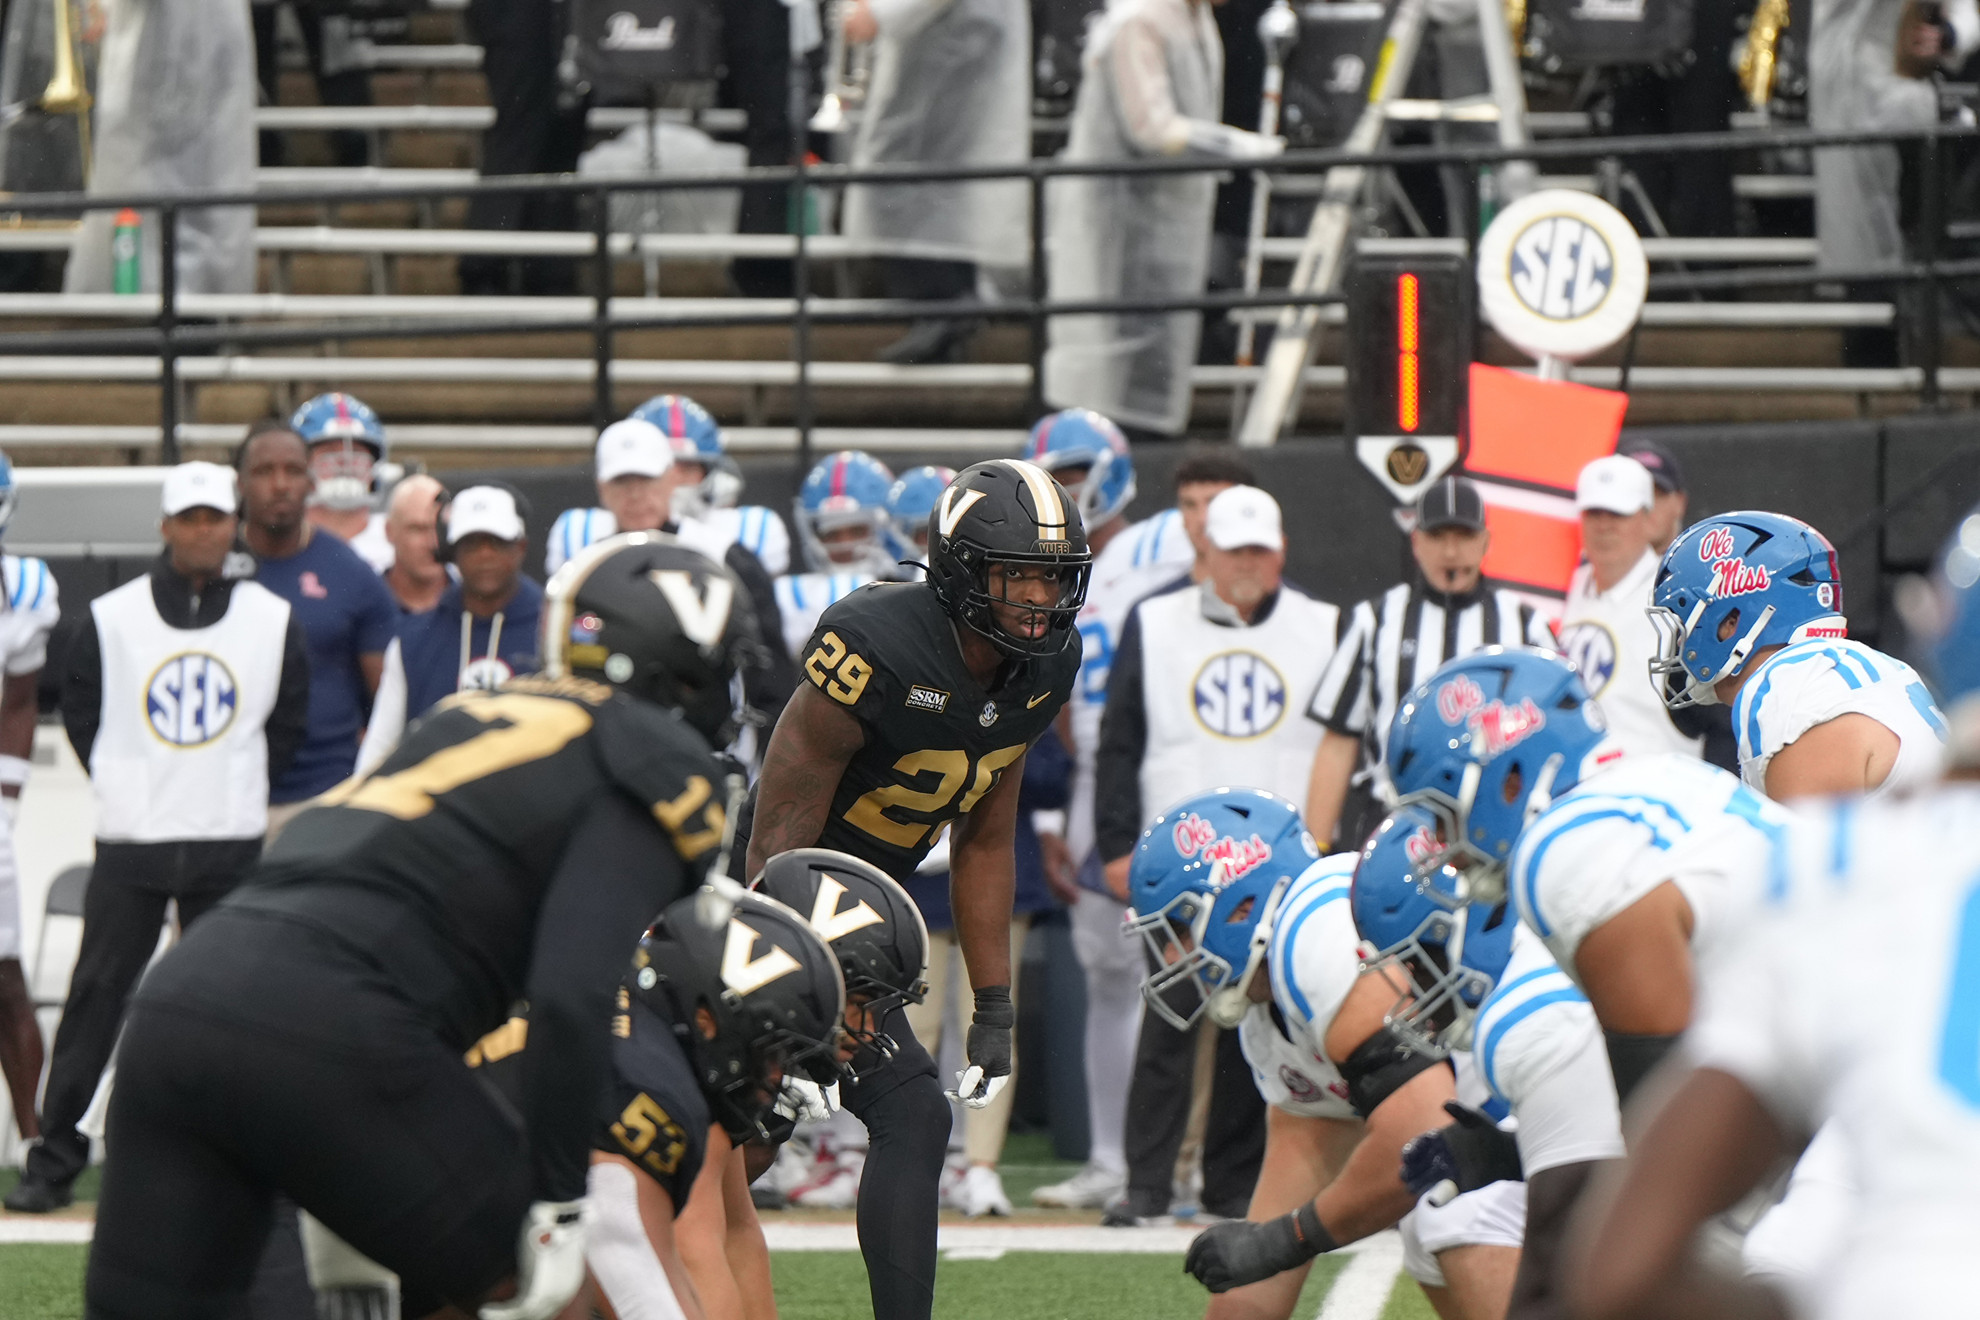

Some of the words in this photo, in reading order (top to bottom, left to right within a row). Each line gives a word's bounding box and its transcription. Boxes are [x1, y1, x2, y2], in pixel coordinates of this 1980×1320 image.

[1511, 217, 1614, 318] SEC
[1399, 272, 1419, 431] 1
[1389, 451, 1427, 484] V
[939, 486, 986, 537] V
[1700, 528, 1734, 561] Ole
[1039, 542, 1070, 554] VUFB
[1714, 558, 1771, 599] Miss
[648, 570, 733, 646] V
[805, 632, 873, 705] 29
[1194, 653, 1286, 738] SEC
[1557, 624, 1616, 699] EC
[147, 655, 237, 746] SEC
[907, 700, 943, 711] CONCRETE
[918, 690, 947, 705] SRM
[1438, 675, 1484, 725] Ole
[322, 692, 593, 821] 7
[1174, 813, 1217, 858] Ole
[811, 872, 885, 941] V
[720, 917, 802, 996] V
[609, 1091, 687, 1174] 53
